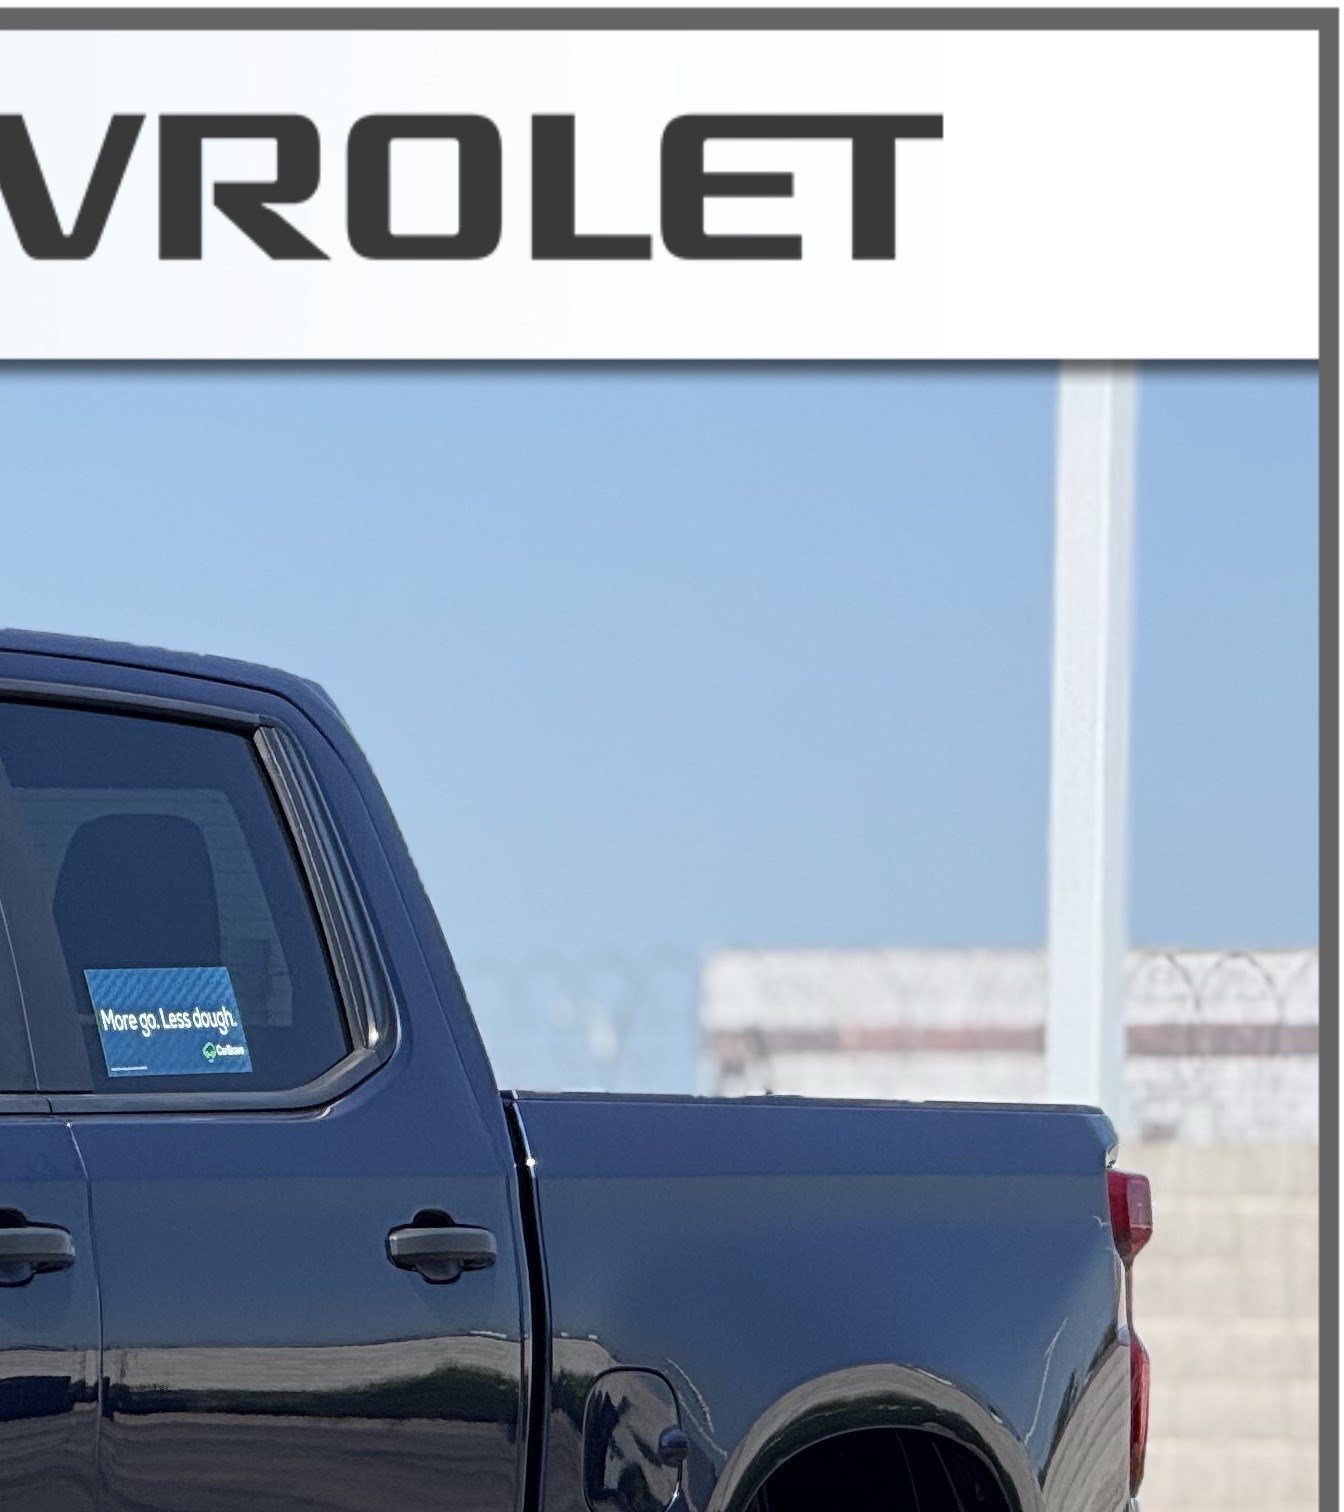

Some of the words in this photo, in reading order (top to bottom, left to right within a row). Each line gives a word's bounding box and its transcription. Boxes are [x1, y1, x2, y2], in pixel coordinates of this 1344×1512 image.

[100, 1009, 138, 1032] More
[139, 1012, 161, 1038] go.
[159, 1007, 193, 1030] Less
[192, 1006, 238, 1037] dough.
